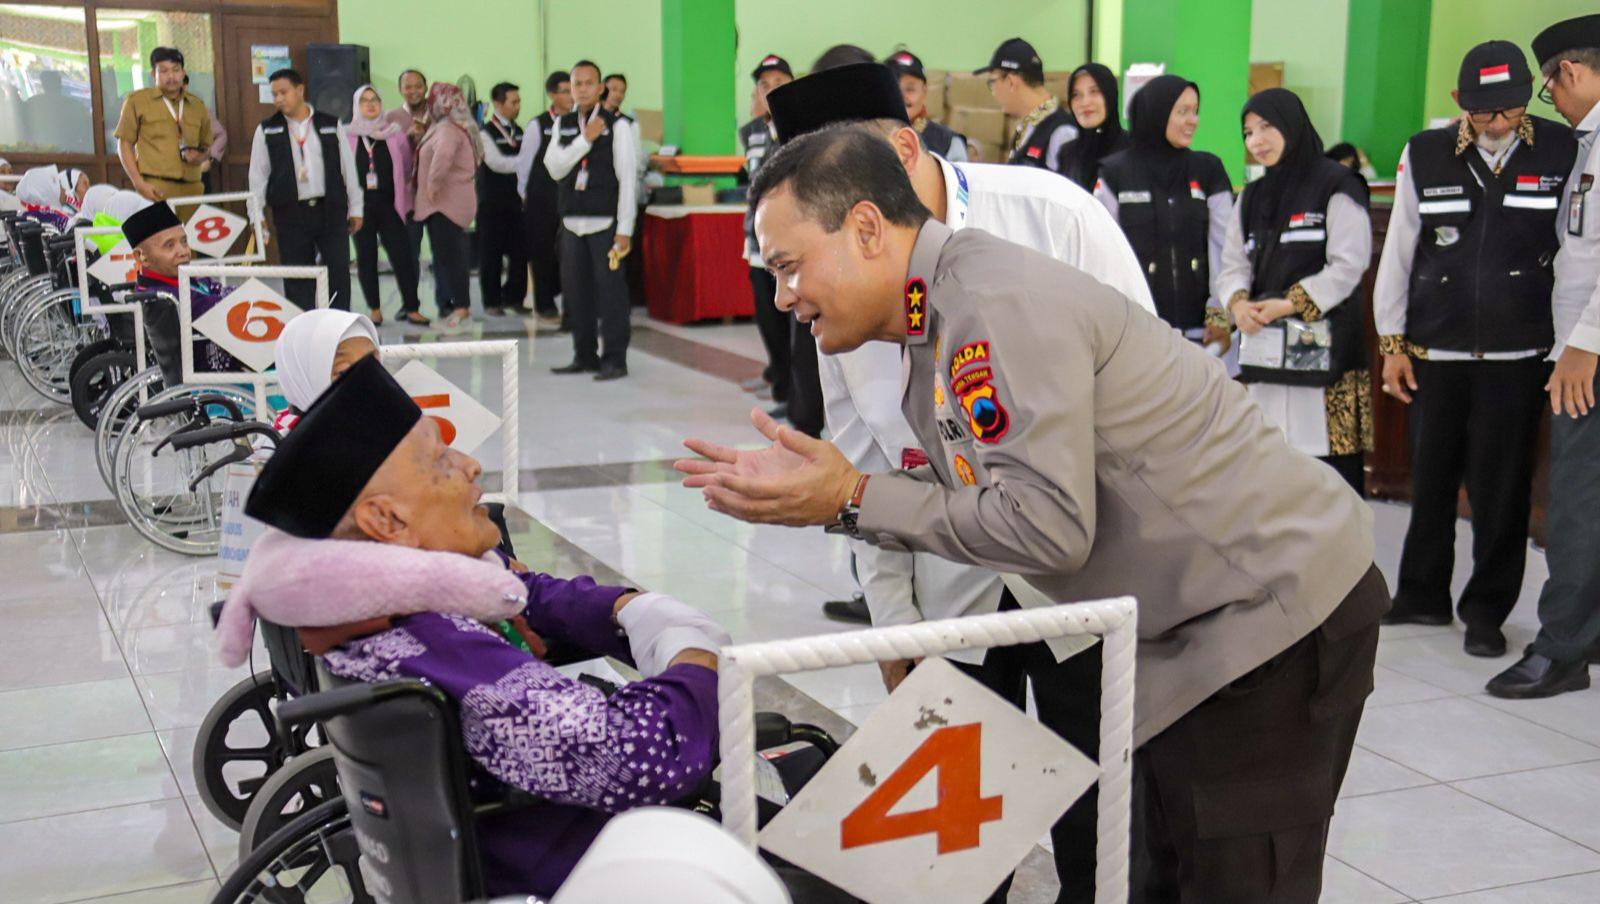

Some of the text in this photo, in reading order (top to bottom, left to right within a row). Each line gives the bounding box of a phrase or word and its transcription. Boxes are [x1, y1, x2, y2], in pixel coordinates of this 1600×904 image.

[194, 216, 231, 244] 8
[226, 300, 286, 343] 6
[937, 418, 966, 441] OLRI
[840, 721, 1003, 857] 4
